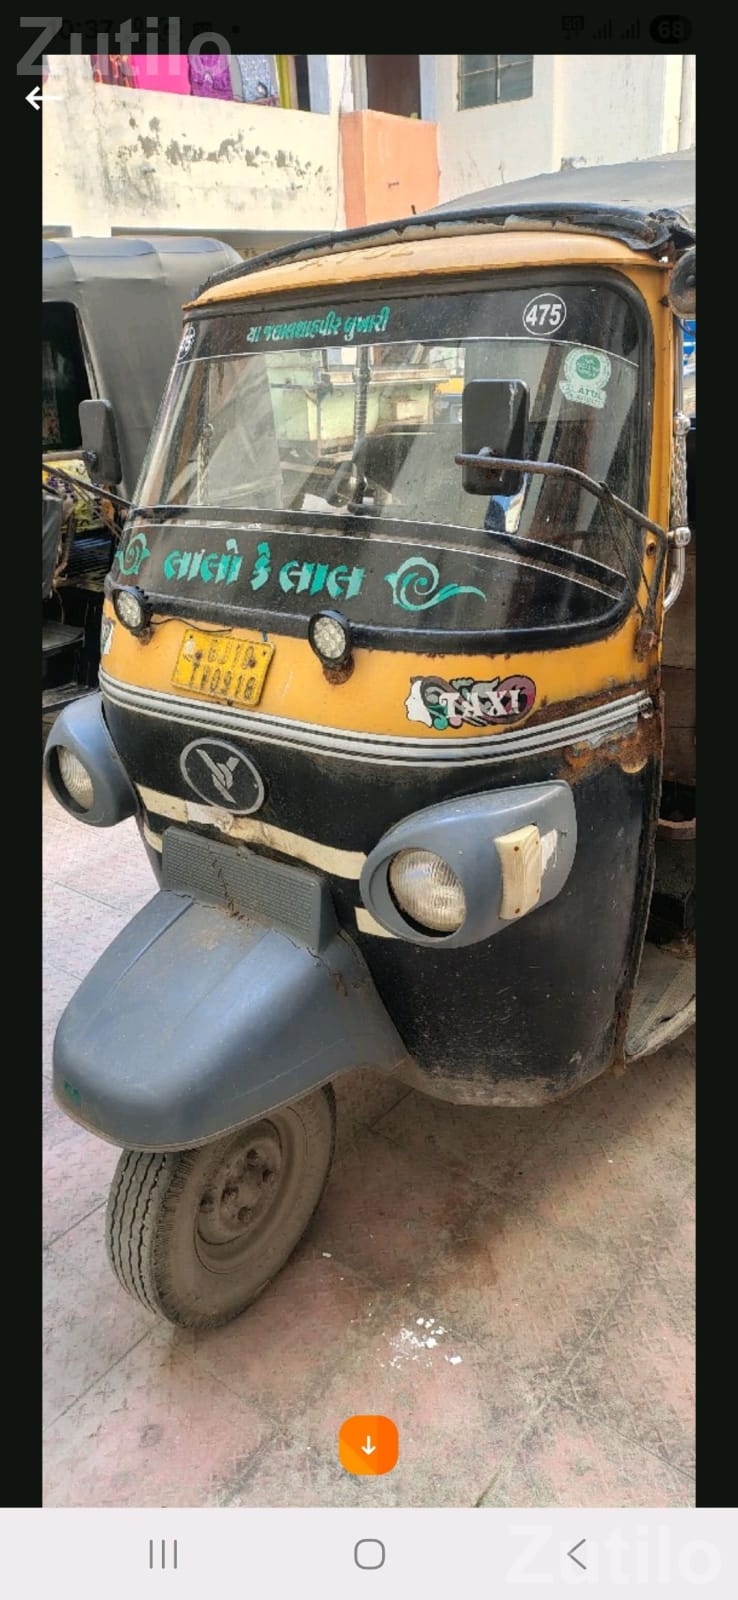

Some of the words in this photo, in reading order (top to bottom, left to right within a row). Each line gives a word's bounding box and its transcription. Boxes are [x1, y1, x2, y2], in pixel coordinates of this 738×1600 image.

[526, 303, 562, 326] 475
[278, 560, 366, 600] લાલ
[439, 689, 521, 719] TAXI
